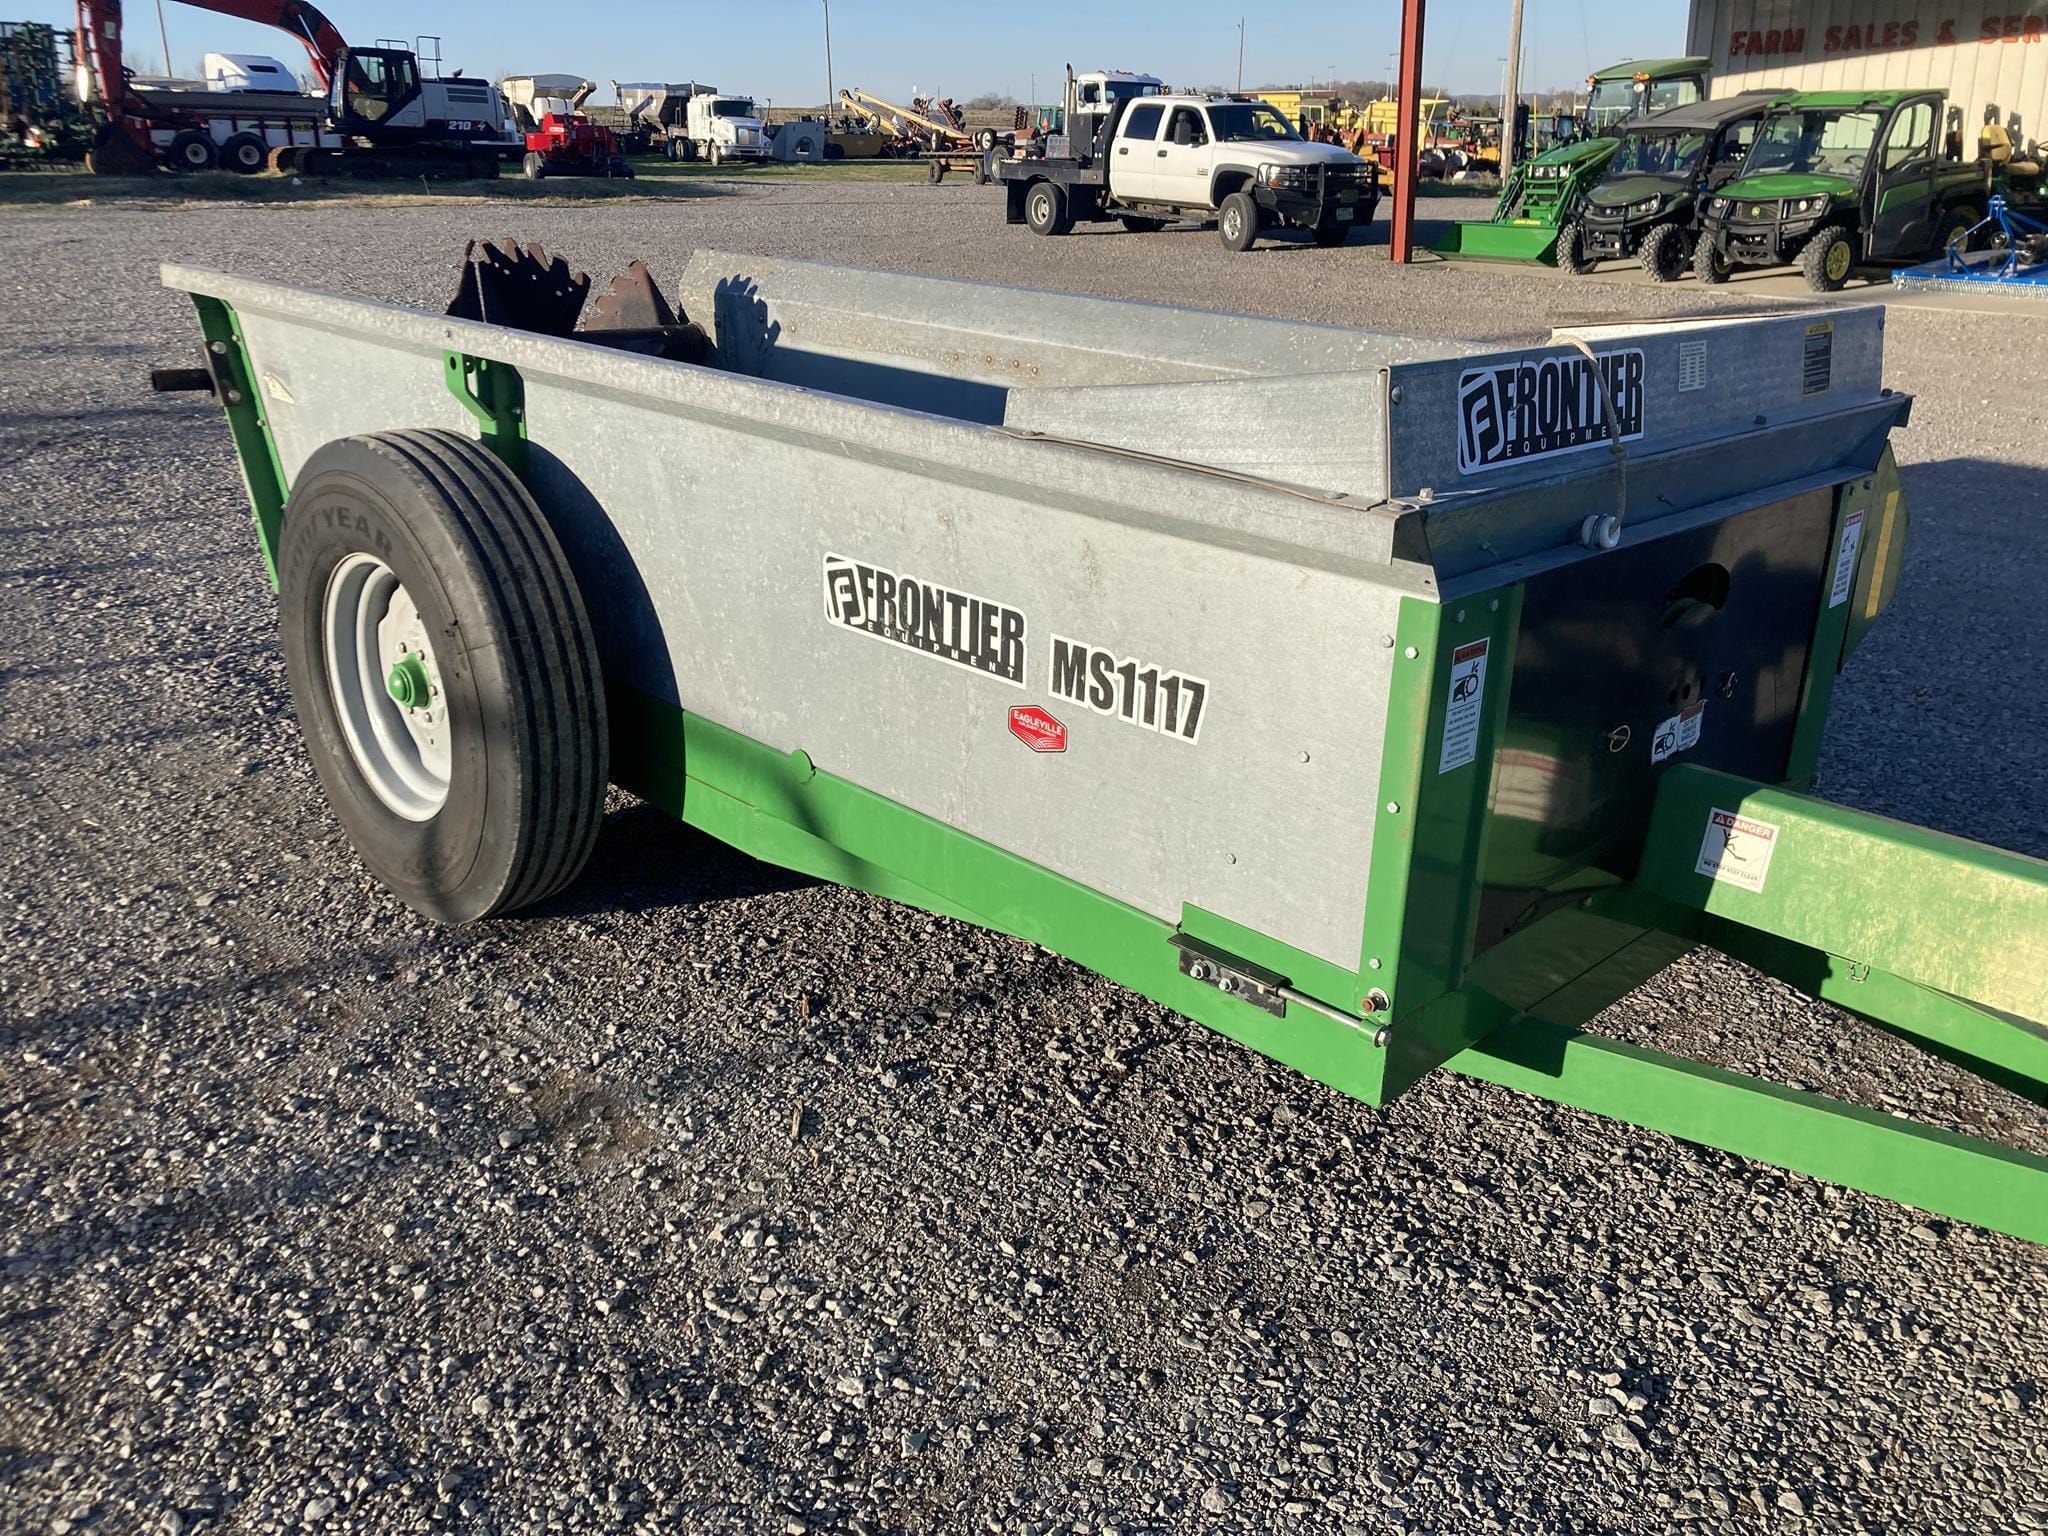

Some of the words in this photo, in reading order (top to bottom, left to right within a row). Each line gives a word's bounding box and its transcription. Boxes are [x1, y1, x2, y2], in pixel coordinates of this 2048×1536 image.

[1731, 28, 1805, 56] FARM
[1824, 20, 1919, 51] SALES
[1936, 19, 1957, 46] &
[1979, 15, 2048, 45] SER
[448, 120, 472, 131] 210
[1494, 353, 1643, 440] FRONTIER
[1506, 420, 1636, 457] EQUIPMENT
[856, 563, 1025, 682] FRONTIER
[867, 620, 1015, 678] EQUIPMENT
[1052, 638, 1205, 740] MS1117
[1013, 709, 1062, 737] EAGLEVILLE
[1726, 817, 1771, 838] DANGER
[1740, 872, 1759, 881] CLEAR
